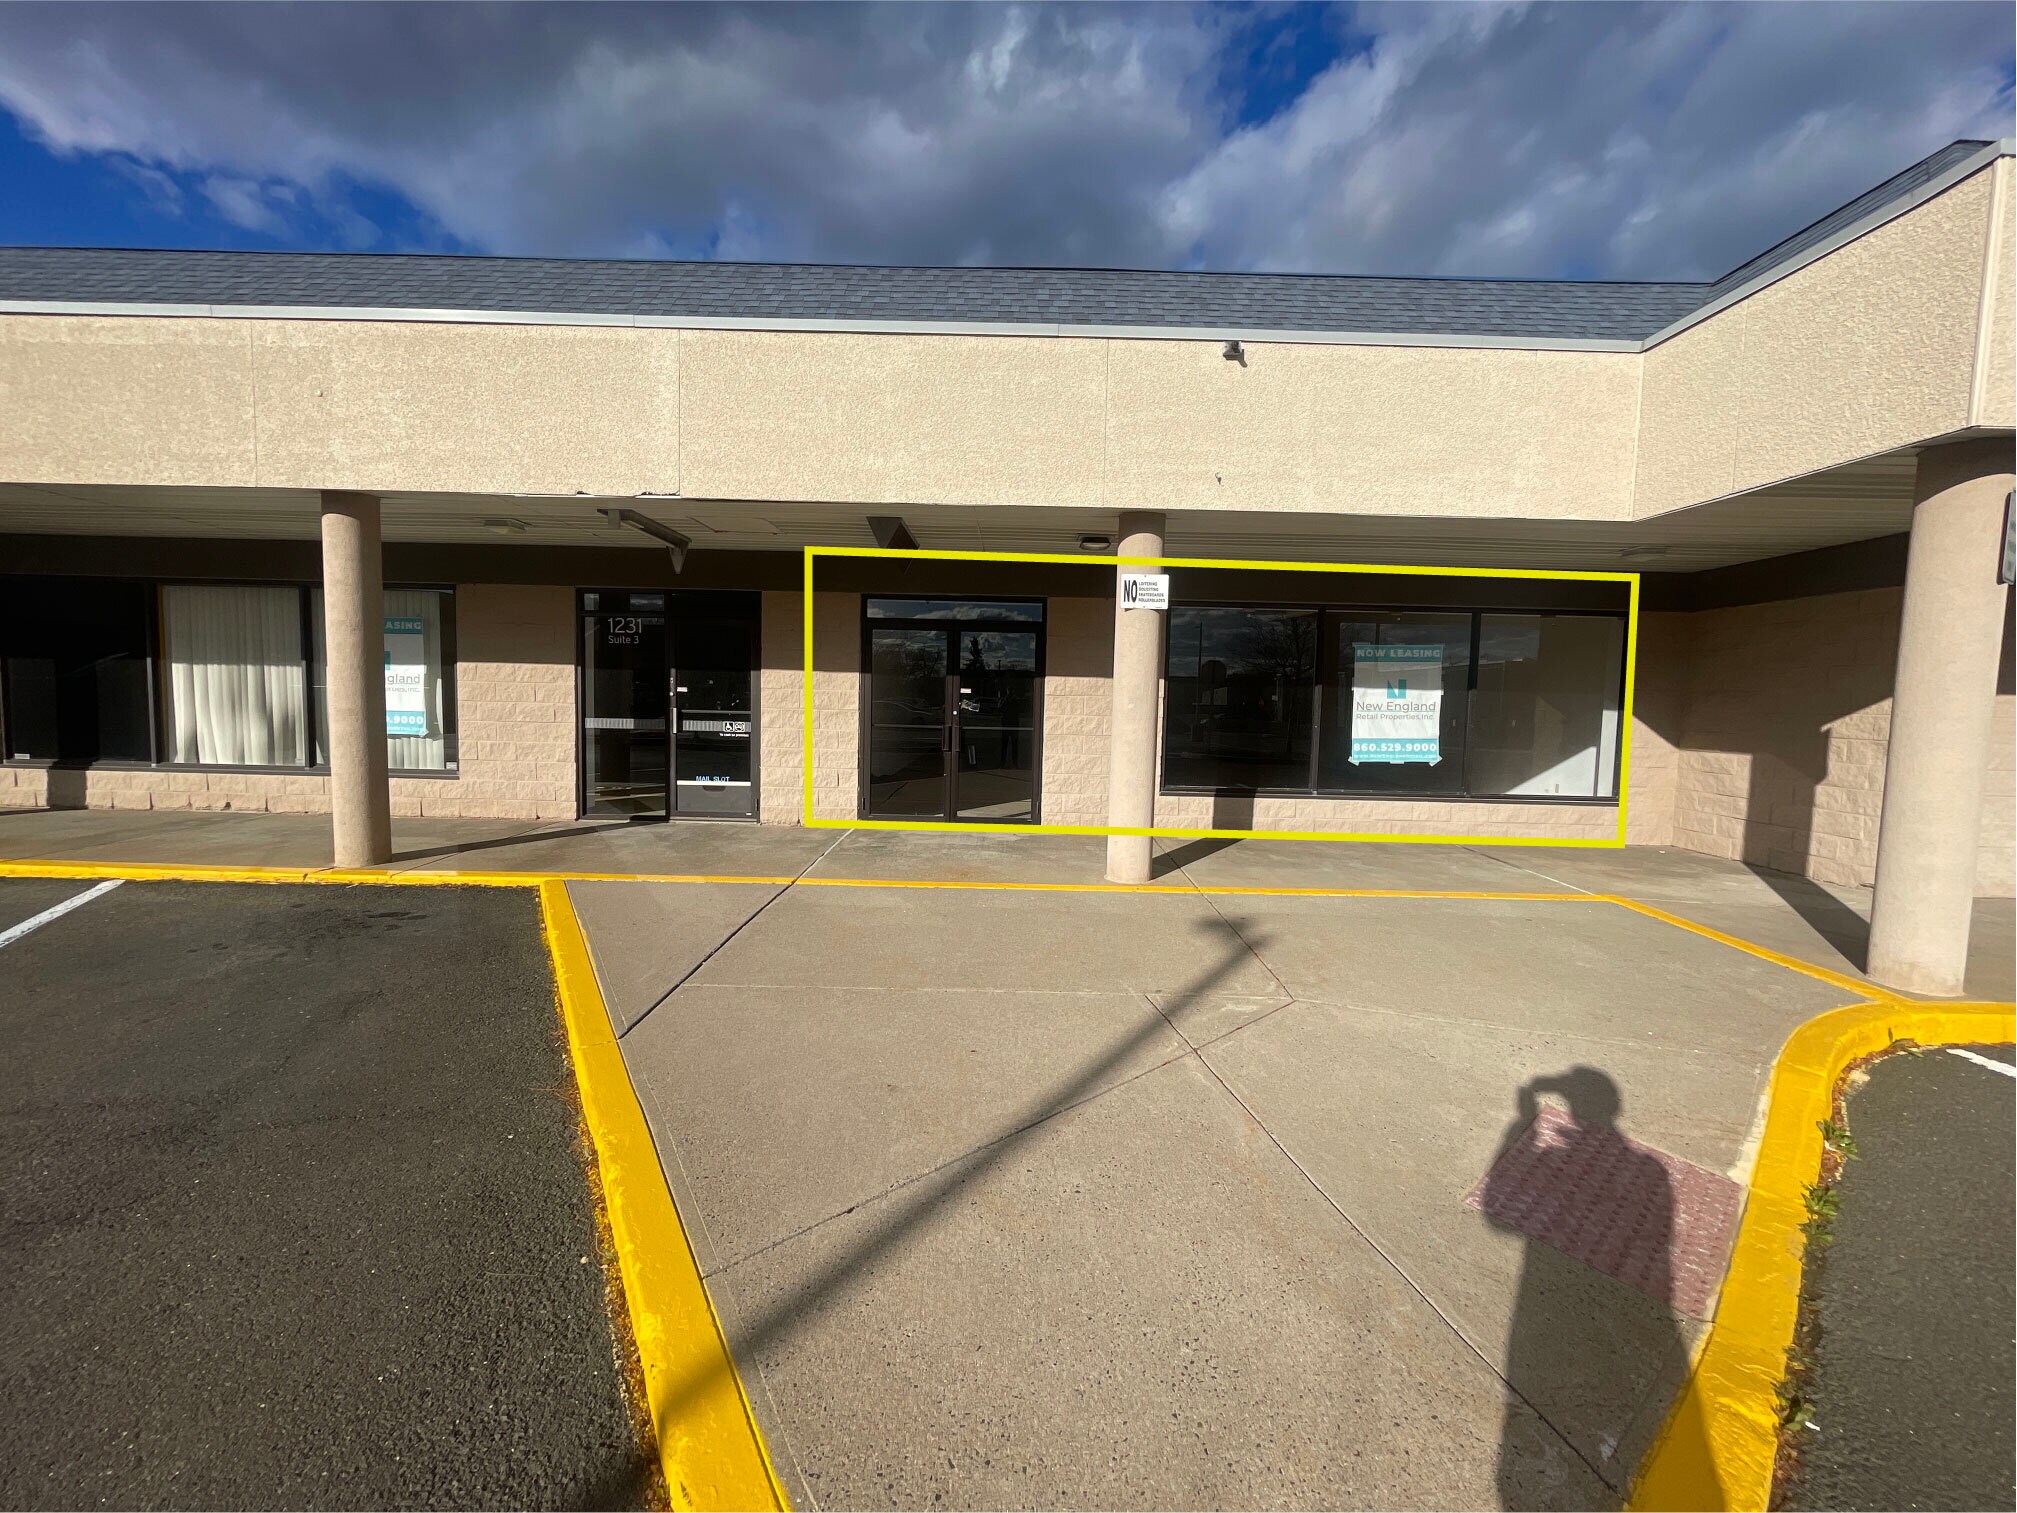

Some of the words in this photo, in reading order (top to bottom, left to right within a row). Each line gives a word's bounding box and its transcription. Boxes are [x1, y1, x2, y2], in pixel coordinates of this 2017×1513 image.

[1123, 579, 1138, 603] NO
[386, 621, 421, 629] ASING
[607, 617, 642, 634] 1231
[608, 635, 631, 644] Suite
[633, 635, 639, 644] 3
[1356, 649, 1386, 657] NOW
[1390, 649, 1440, 657] LEASING
[387, 673, 421, 685] gland
[1356, 701, 1383, 711] New
[1387, 701, 1436, 712] England
[1353, 743, 1437, 752] 860.529.9000
